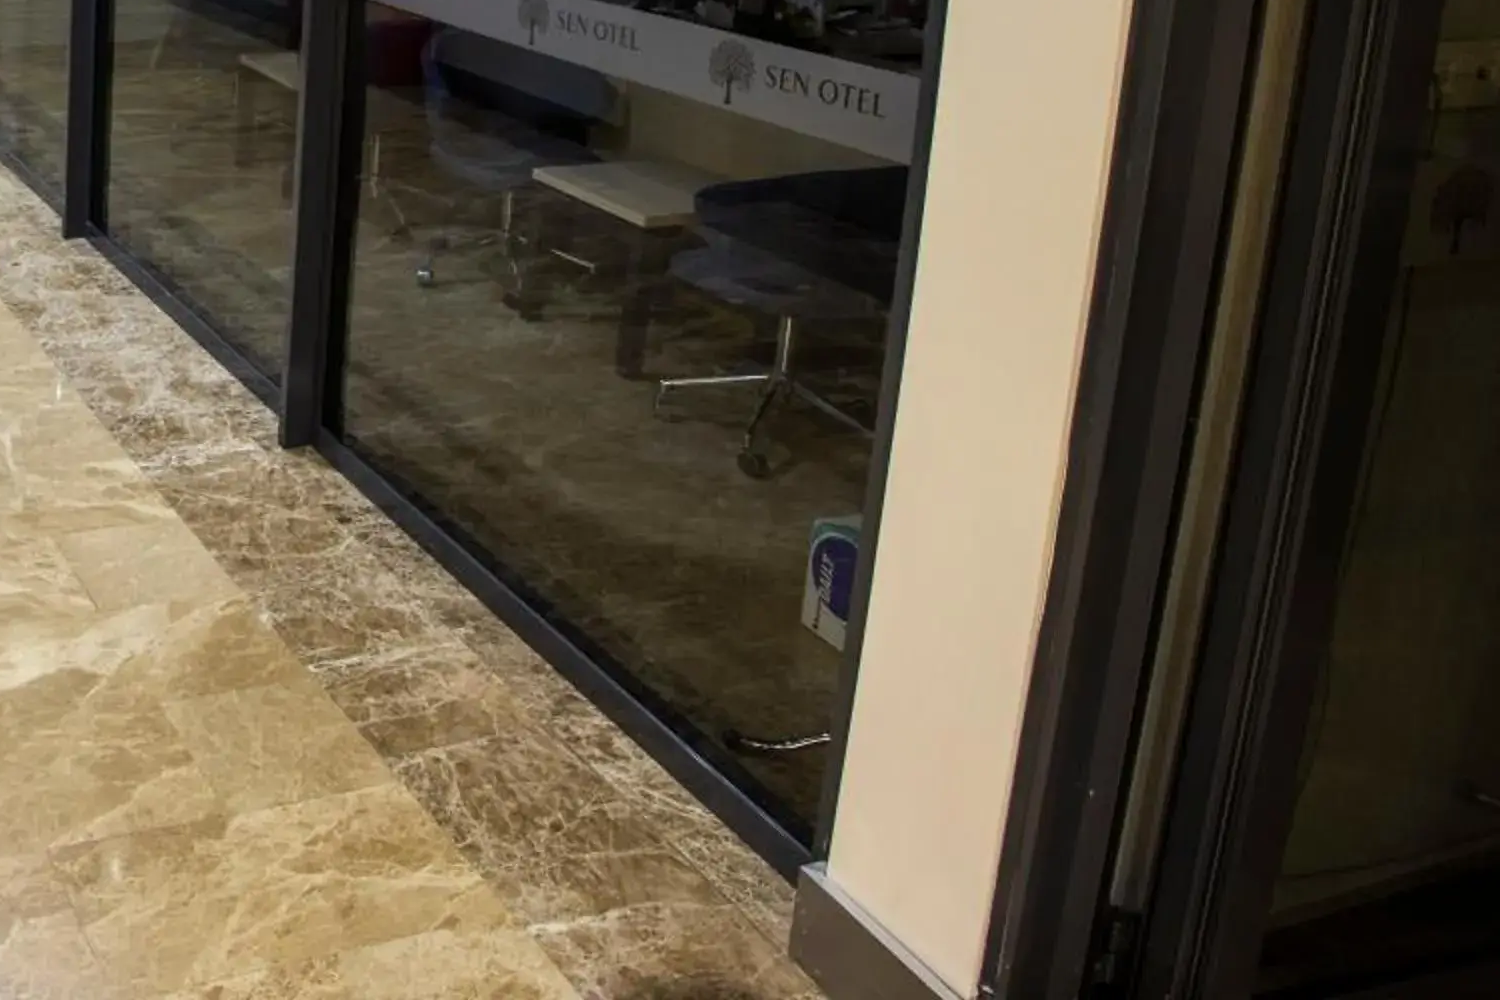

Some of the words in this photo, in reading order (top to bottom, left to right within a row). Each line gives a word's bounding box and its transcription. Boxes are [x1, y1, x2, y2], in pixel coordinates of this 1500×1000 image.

[555, 8, 588, 37] SEN
[594, 21, 641, 52] OTEL
[765, 64, 810, 98] SEN
[818, 78, 887, 119] OTEL
